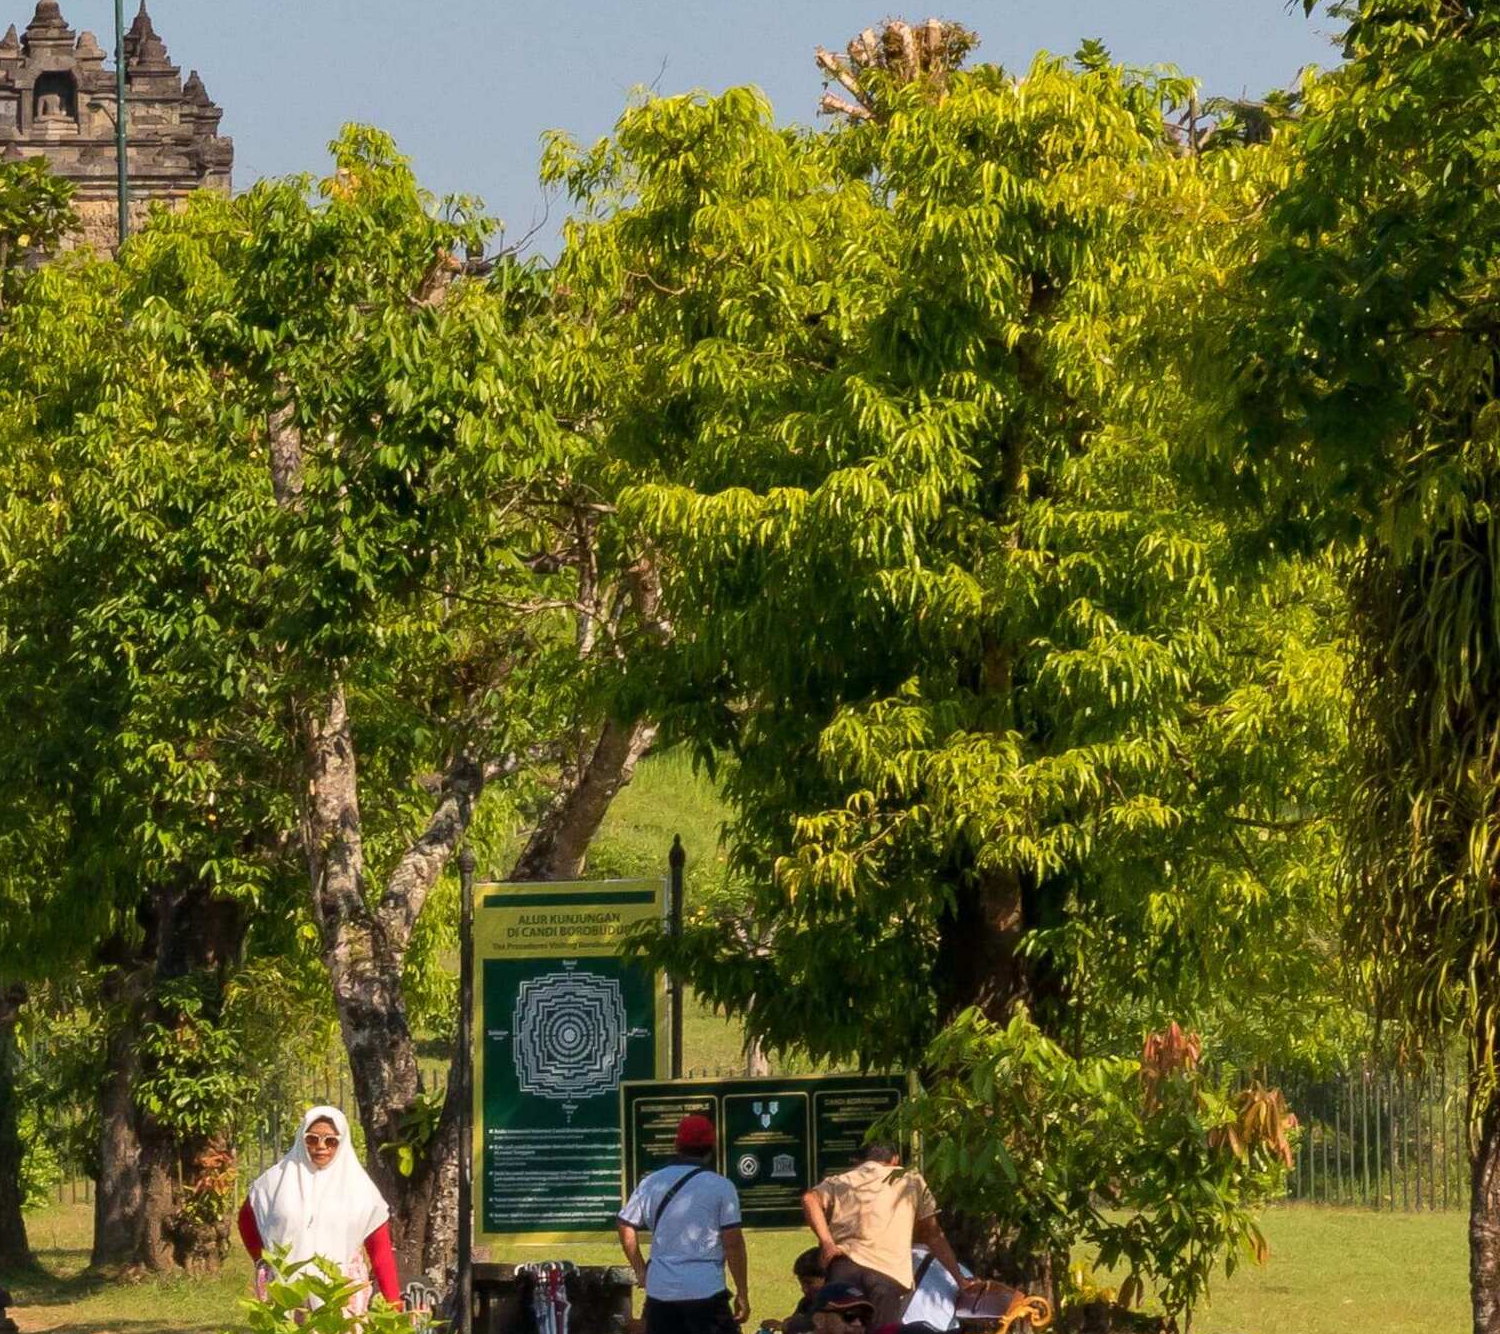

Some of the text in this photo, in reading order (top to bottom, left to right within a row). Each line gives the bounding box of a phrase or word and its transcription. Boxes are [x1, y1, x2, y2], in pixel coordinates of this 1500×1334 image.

[518, 913, 621, 925] ALUR KUNJUNGAN
[507, 927, 521, 938] DI
[521, 926, 557, 938] CANDI
